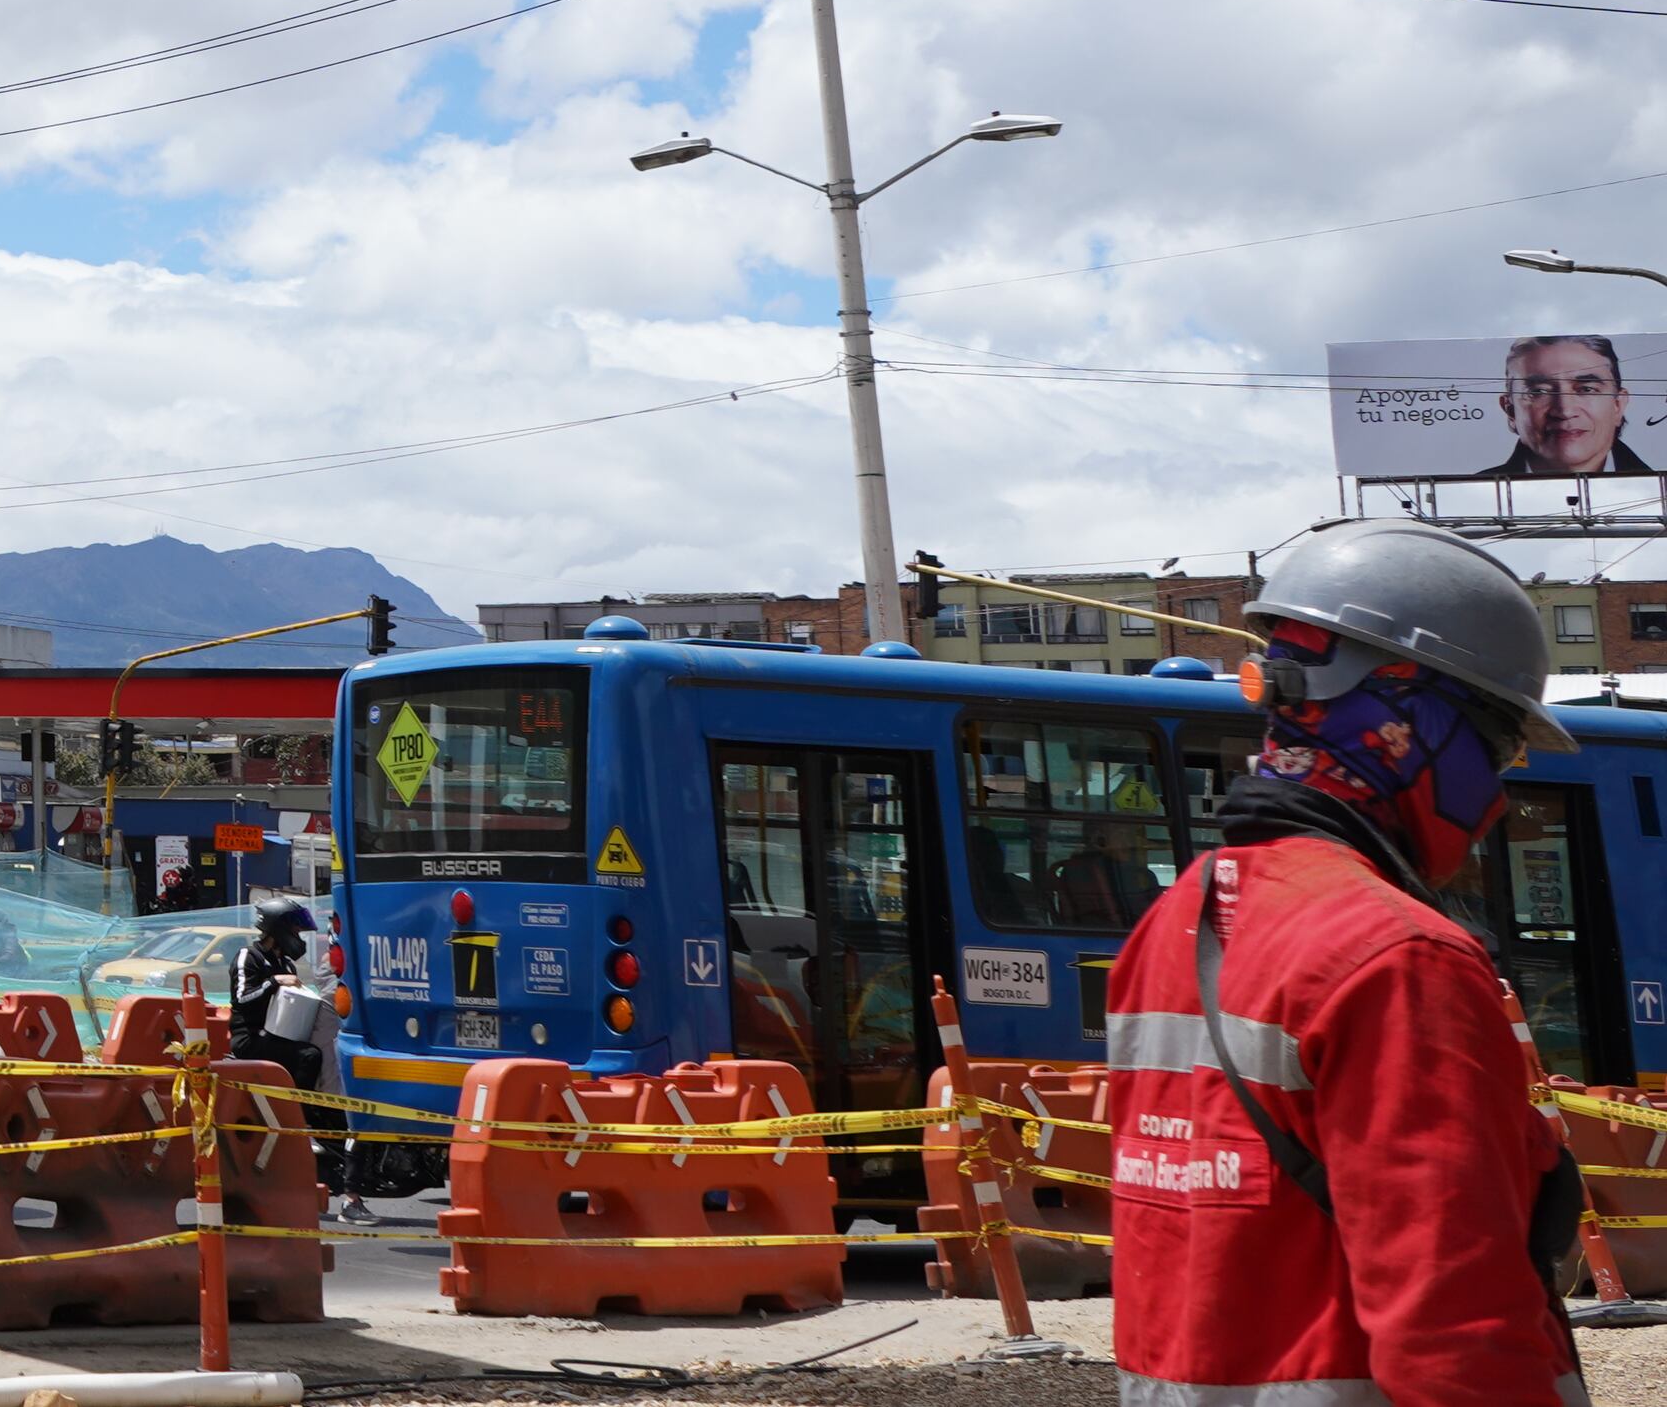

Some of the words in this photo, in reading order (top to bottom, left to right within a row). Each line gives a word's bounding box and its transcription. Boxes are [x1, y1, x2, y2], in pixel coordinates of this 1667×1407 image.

[1355, 384, 1460, 407] Apoyaré
[1356, 408, 1384, 423] tu
[1392, 404, 1484, 426] negocio
[392, 732, 424, 763] TP80
[20, 783, 28, 794] 8
[221, 826, 259, 839] SENDERO
[422, 860, 501, 876] BUSSCAR
[596, 876, 618, 887] PUNTO
[620, 877, 645, 888] CIEGO
[369, 935, 429, 980] Z10-4492
[534, 950, 555, 962] CEDA
[530, 963, 540, 975] EL
[541, 964, 563, 976] PASO
[966, 959, 1002, 981] WGH
[1012, 962, 1045, 984] 384
[982, 988, 1015, 999] BOGOTA
[1217, 1150, 1241, 1190] 68
